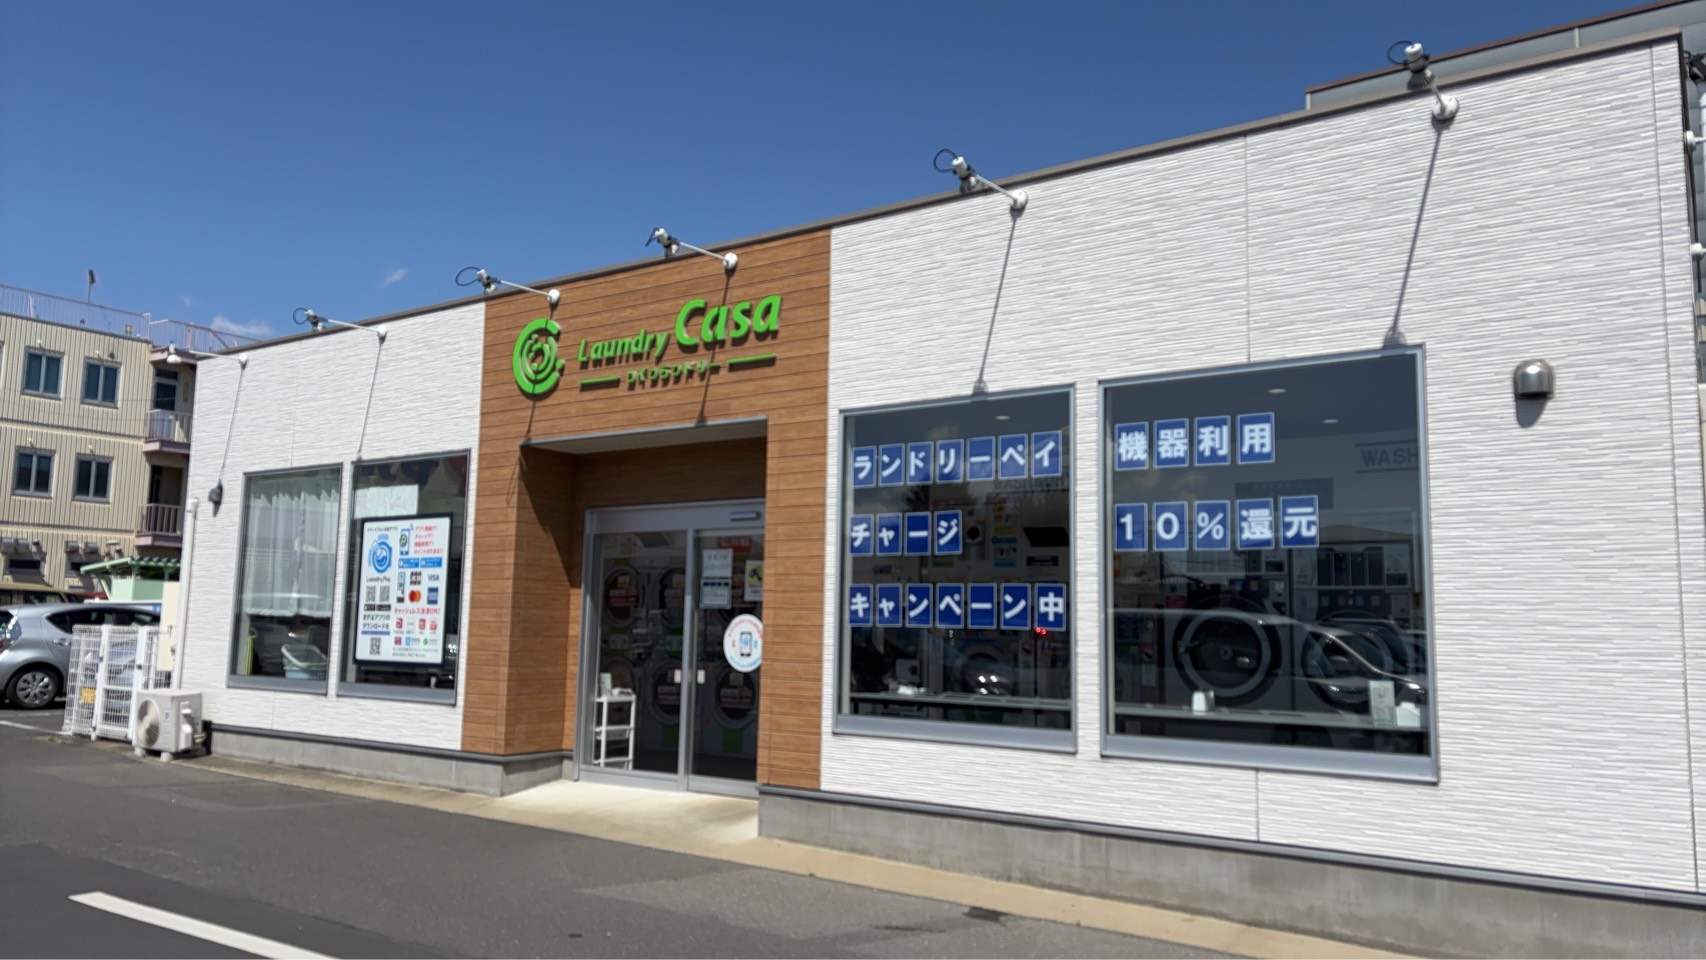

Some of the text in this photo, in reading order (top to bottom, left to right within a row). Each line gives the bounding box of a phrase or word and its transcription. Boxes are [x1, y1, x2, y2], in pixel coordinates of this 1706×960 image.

[577, 294, 781, 362] Laundry Casa
[853, 440, 1057, 480] ランドリーペイ
[1117, 422, 1273, 462] 機器利用
[850, 518, 959, 548] チャージ
[1119, 506, 1319, 541] 10%還元
[849, 591, 1065, 622] キャンペーン中
